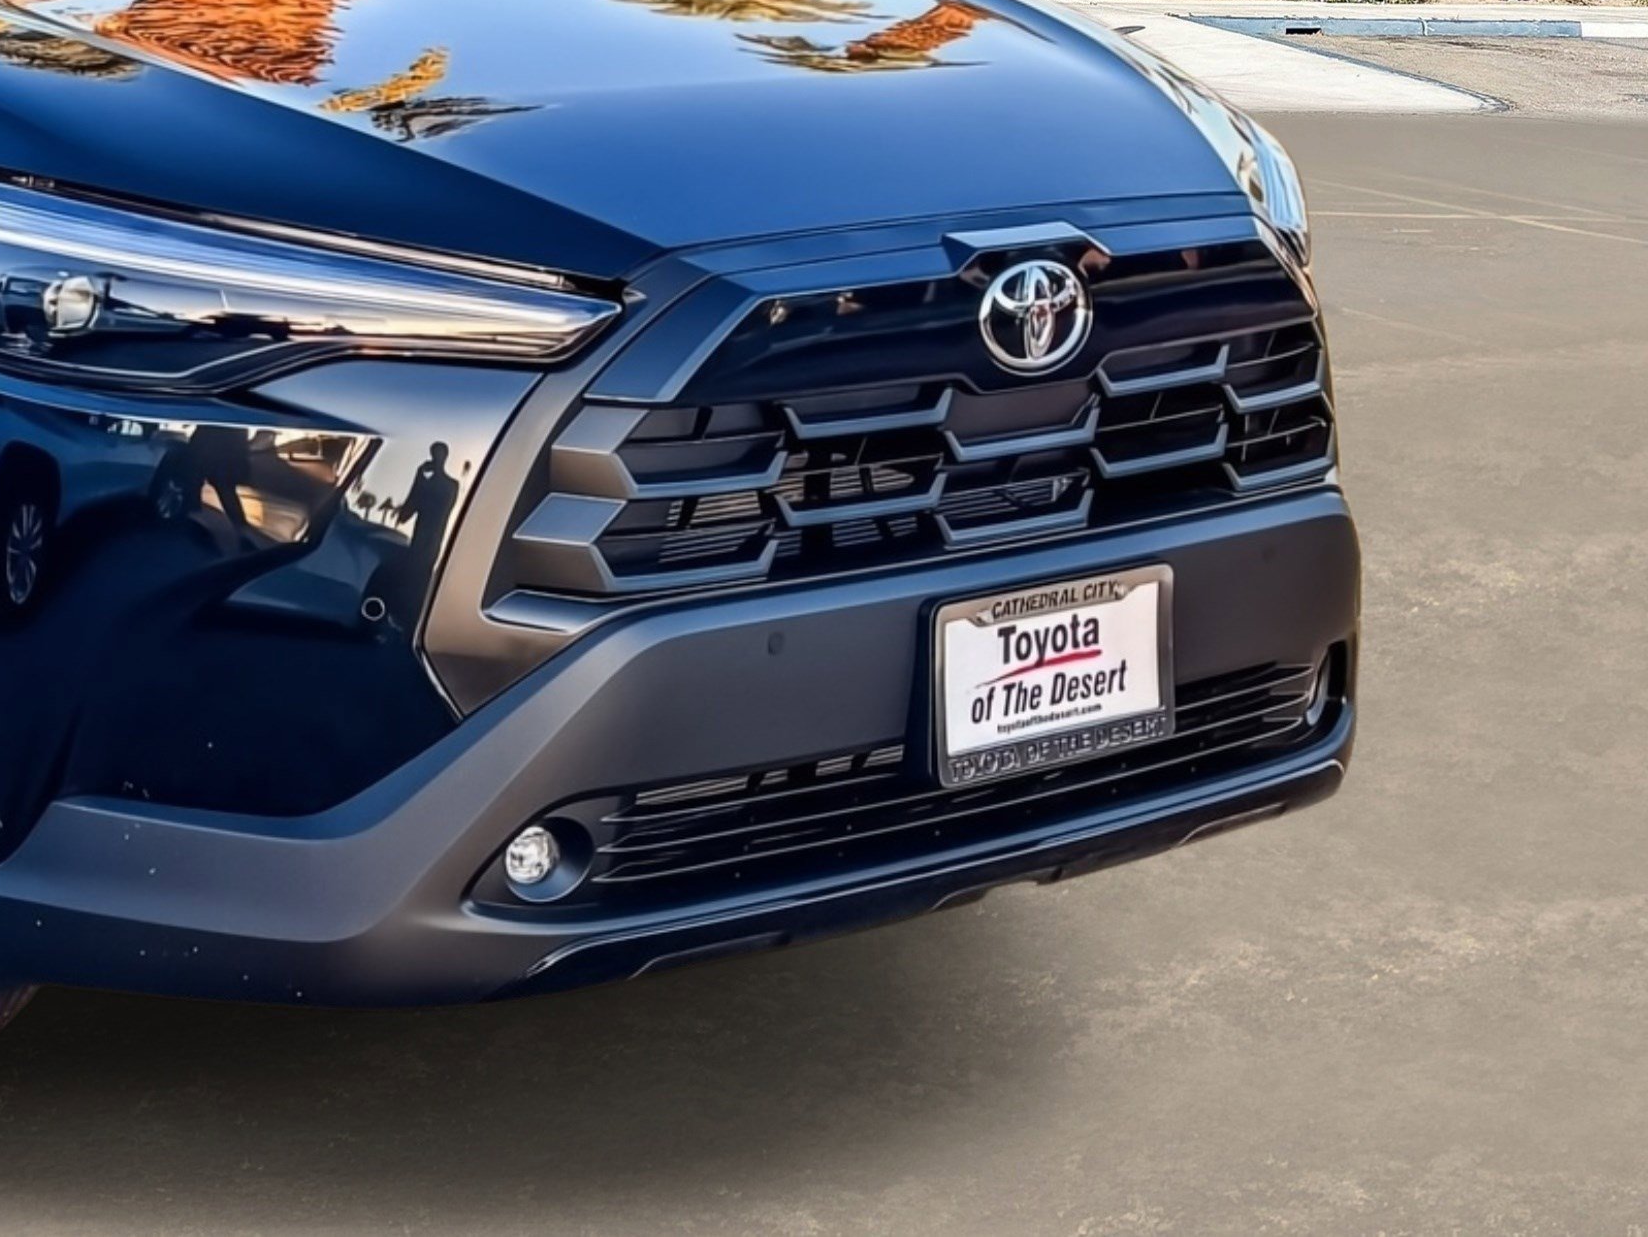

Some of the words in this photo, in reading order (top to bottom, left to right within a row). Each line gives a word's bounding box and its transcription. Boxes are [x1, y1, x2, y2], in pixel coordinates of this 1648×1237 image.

[992, 587, 1079, 619] CATHEDRAL
[1083, 580, 1118, 601] CITY
[997, 614, 1100, 667] Toyota
[971, 686, 996, 724] of
[1003, 680, 1043, 717] The
[1050, 659, 1127, 706] Desert
